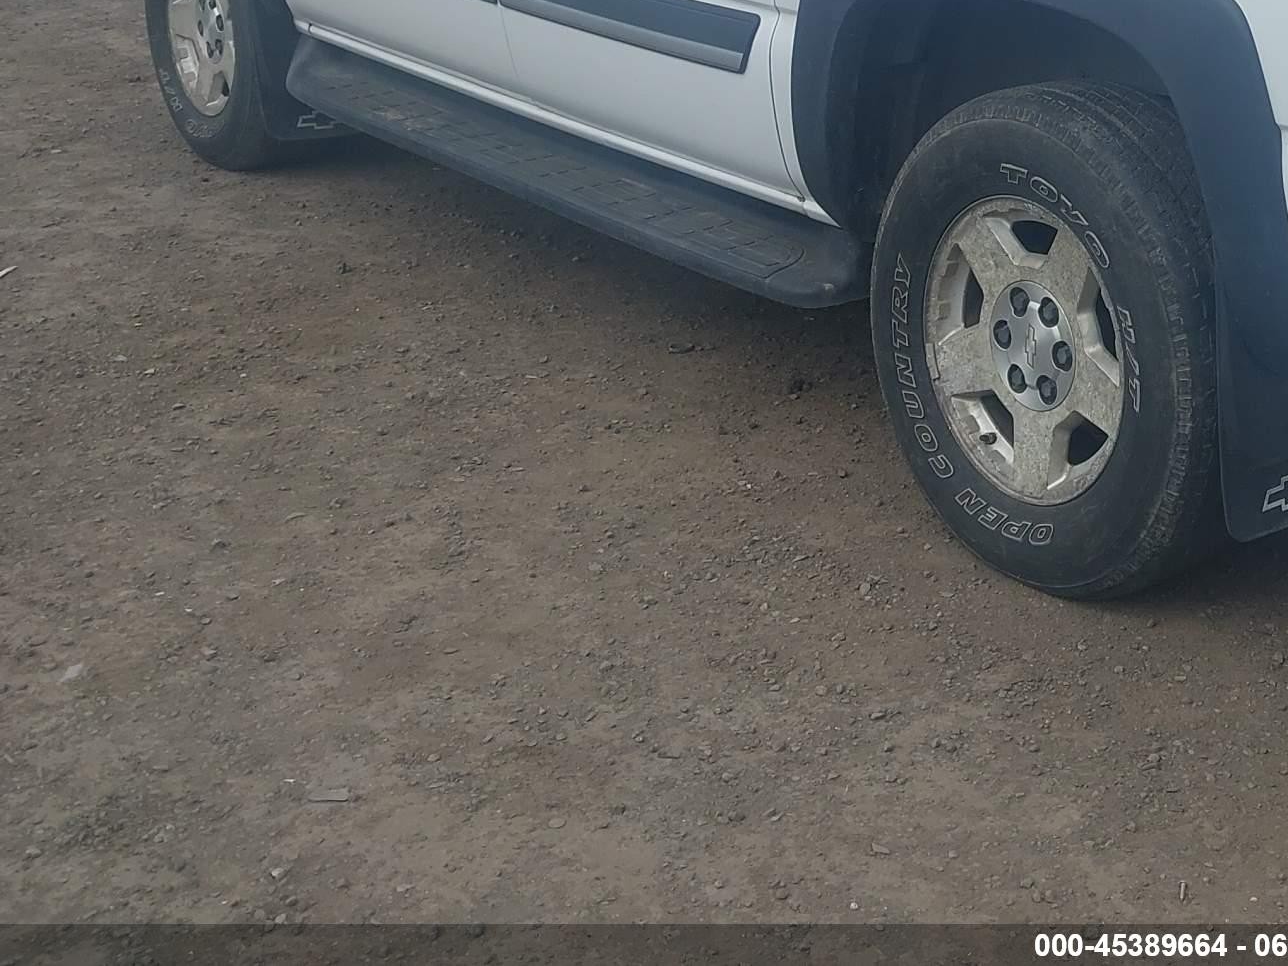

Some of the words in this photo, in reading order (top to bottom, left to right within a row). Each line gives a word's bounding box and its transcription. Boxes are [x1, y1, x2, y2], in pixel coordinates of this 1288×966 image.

[1000, 162, 1111, 270] TOYO
[890, 253, 956, 480] COUNTRY
[954, 487, 1055, 546] OPEN
